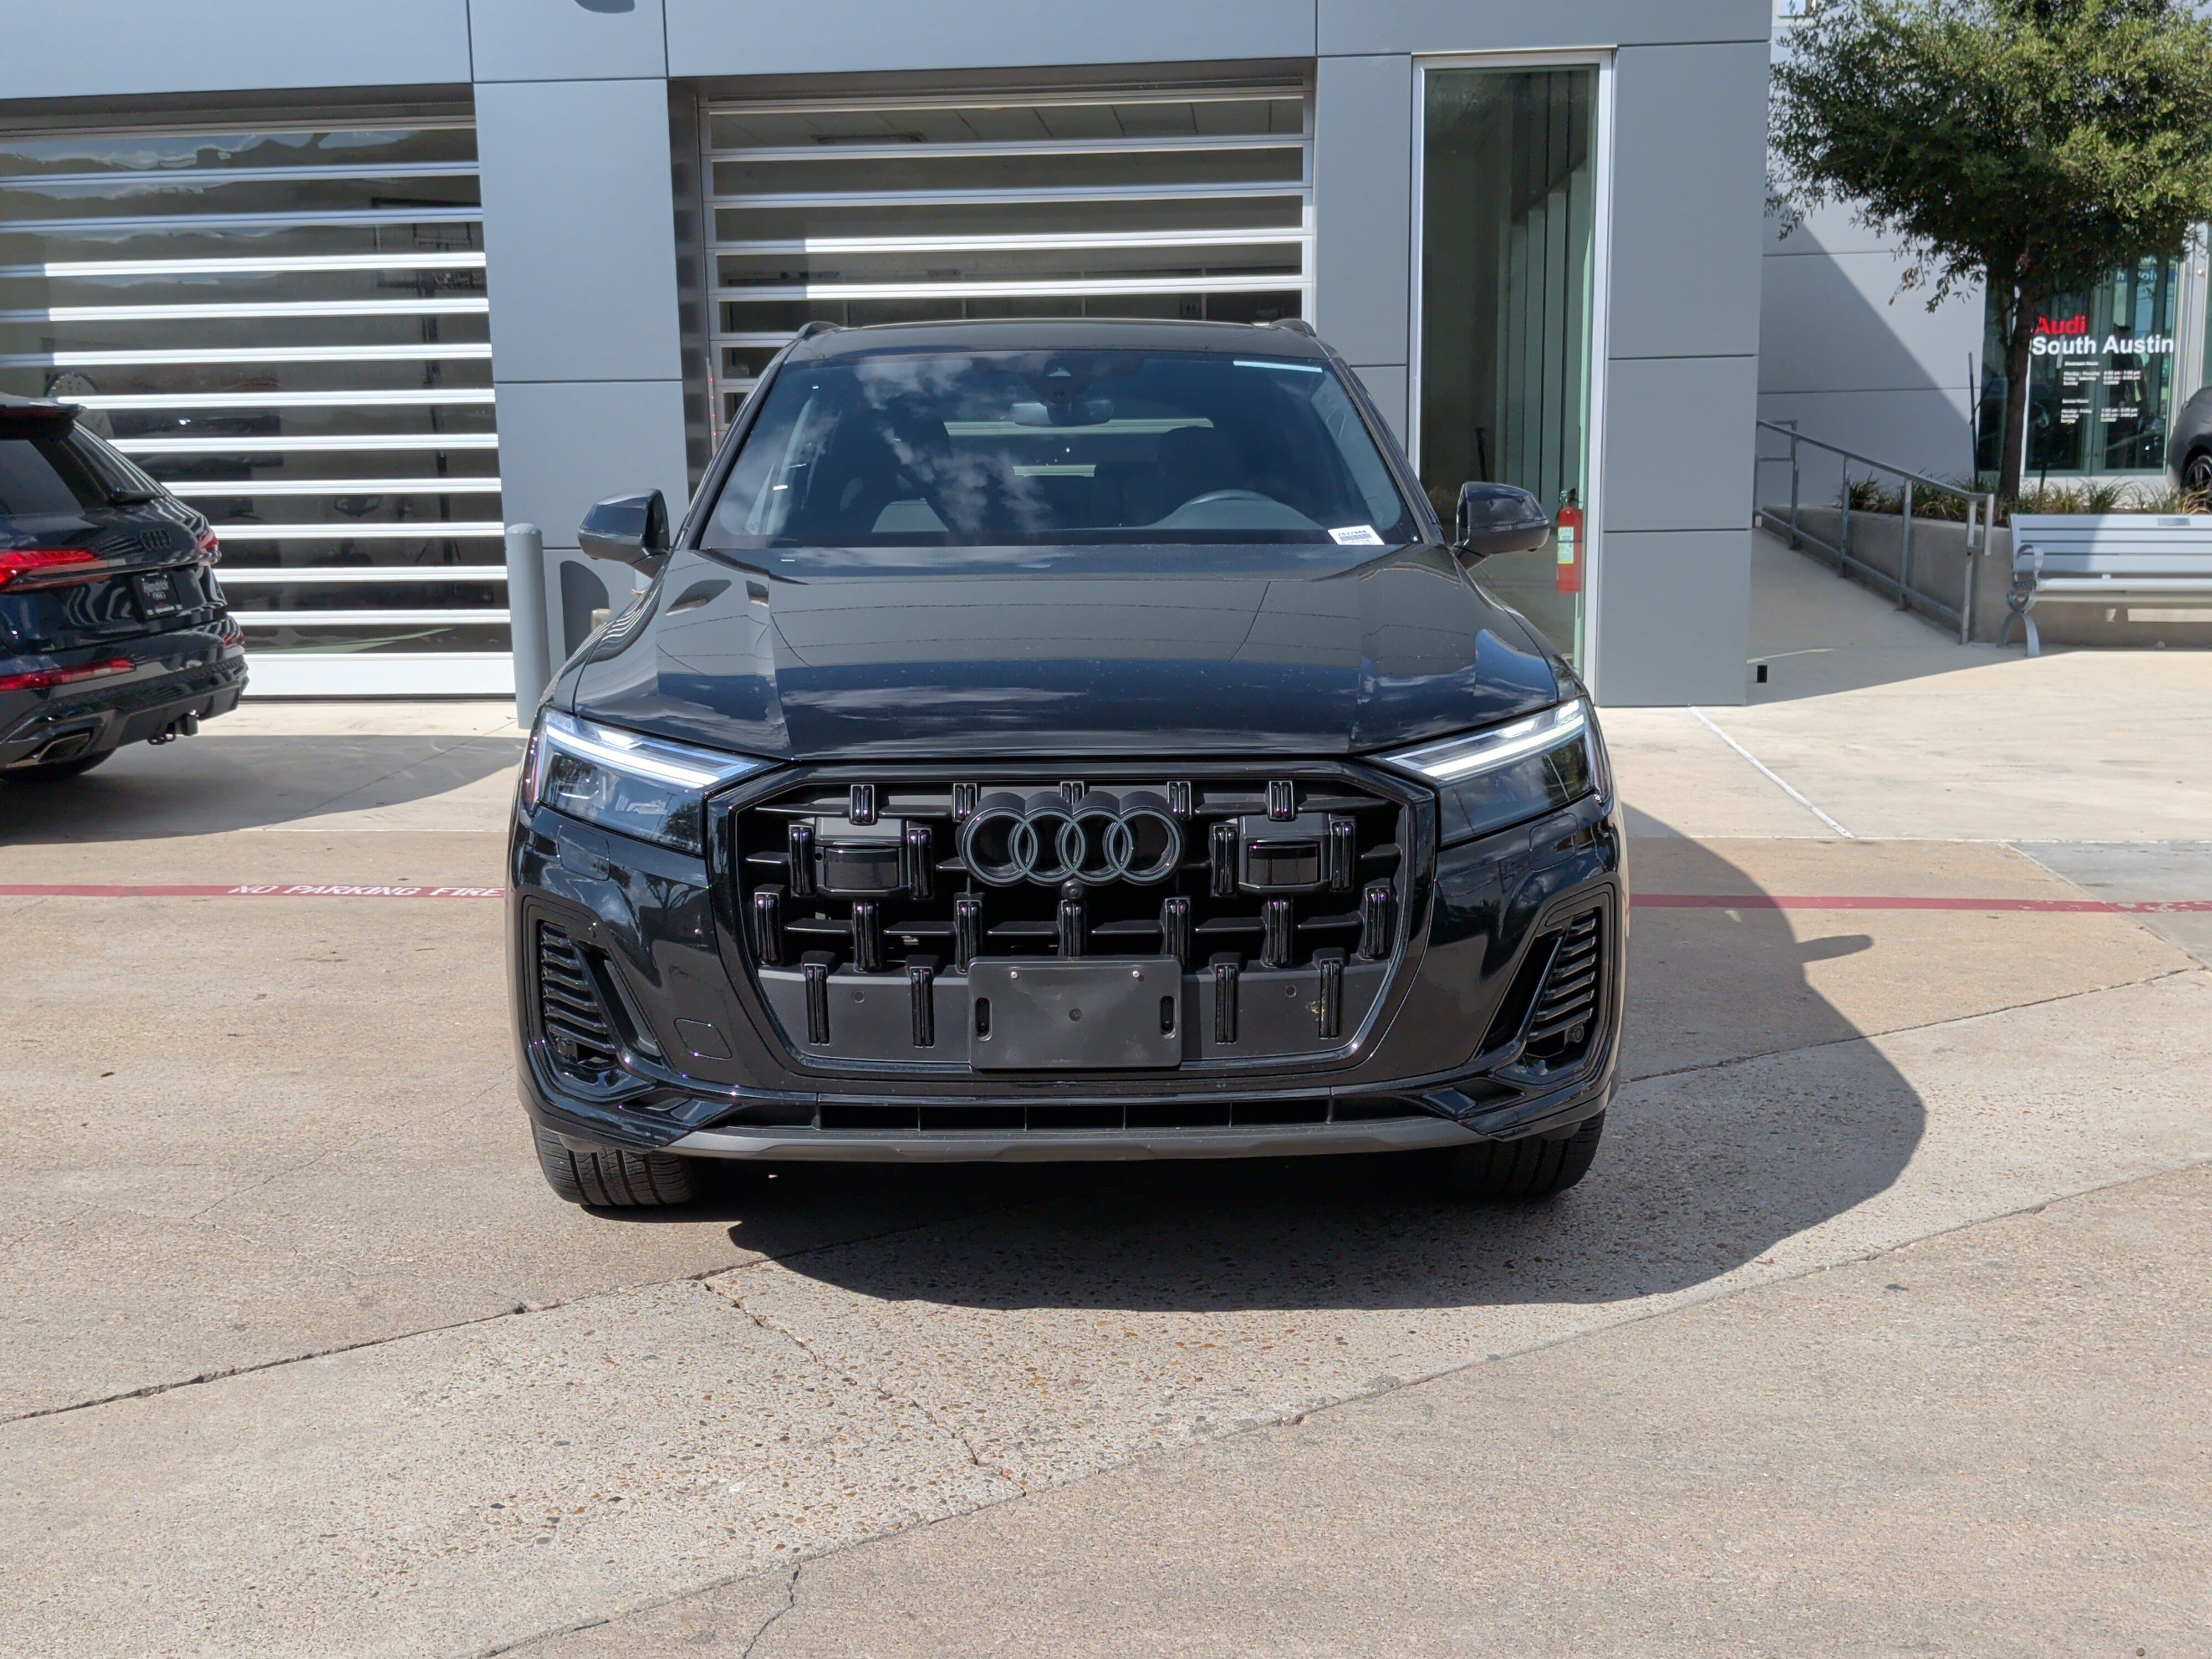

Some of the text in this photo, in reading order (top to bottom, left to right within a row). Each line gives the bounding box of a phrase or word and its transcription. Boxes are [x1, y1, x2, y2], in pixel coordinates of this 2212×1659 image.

[2034, 315, 2087, 334] Audi
[2032, 333, 2174, 355] South Austin
[227, 885, 506, 896] NO PARKING FIRE
